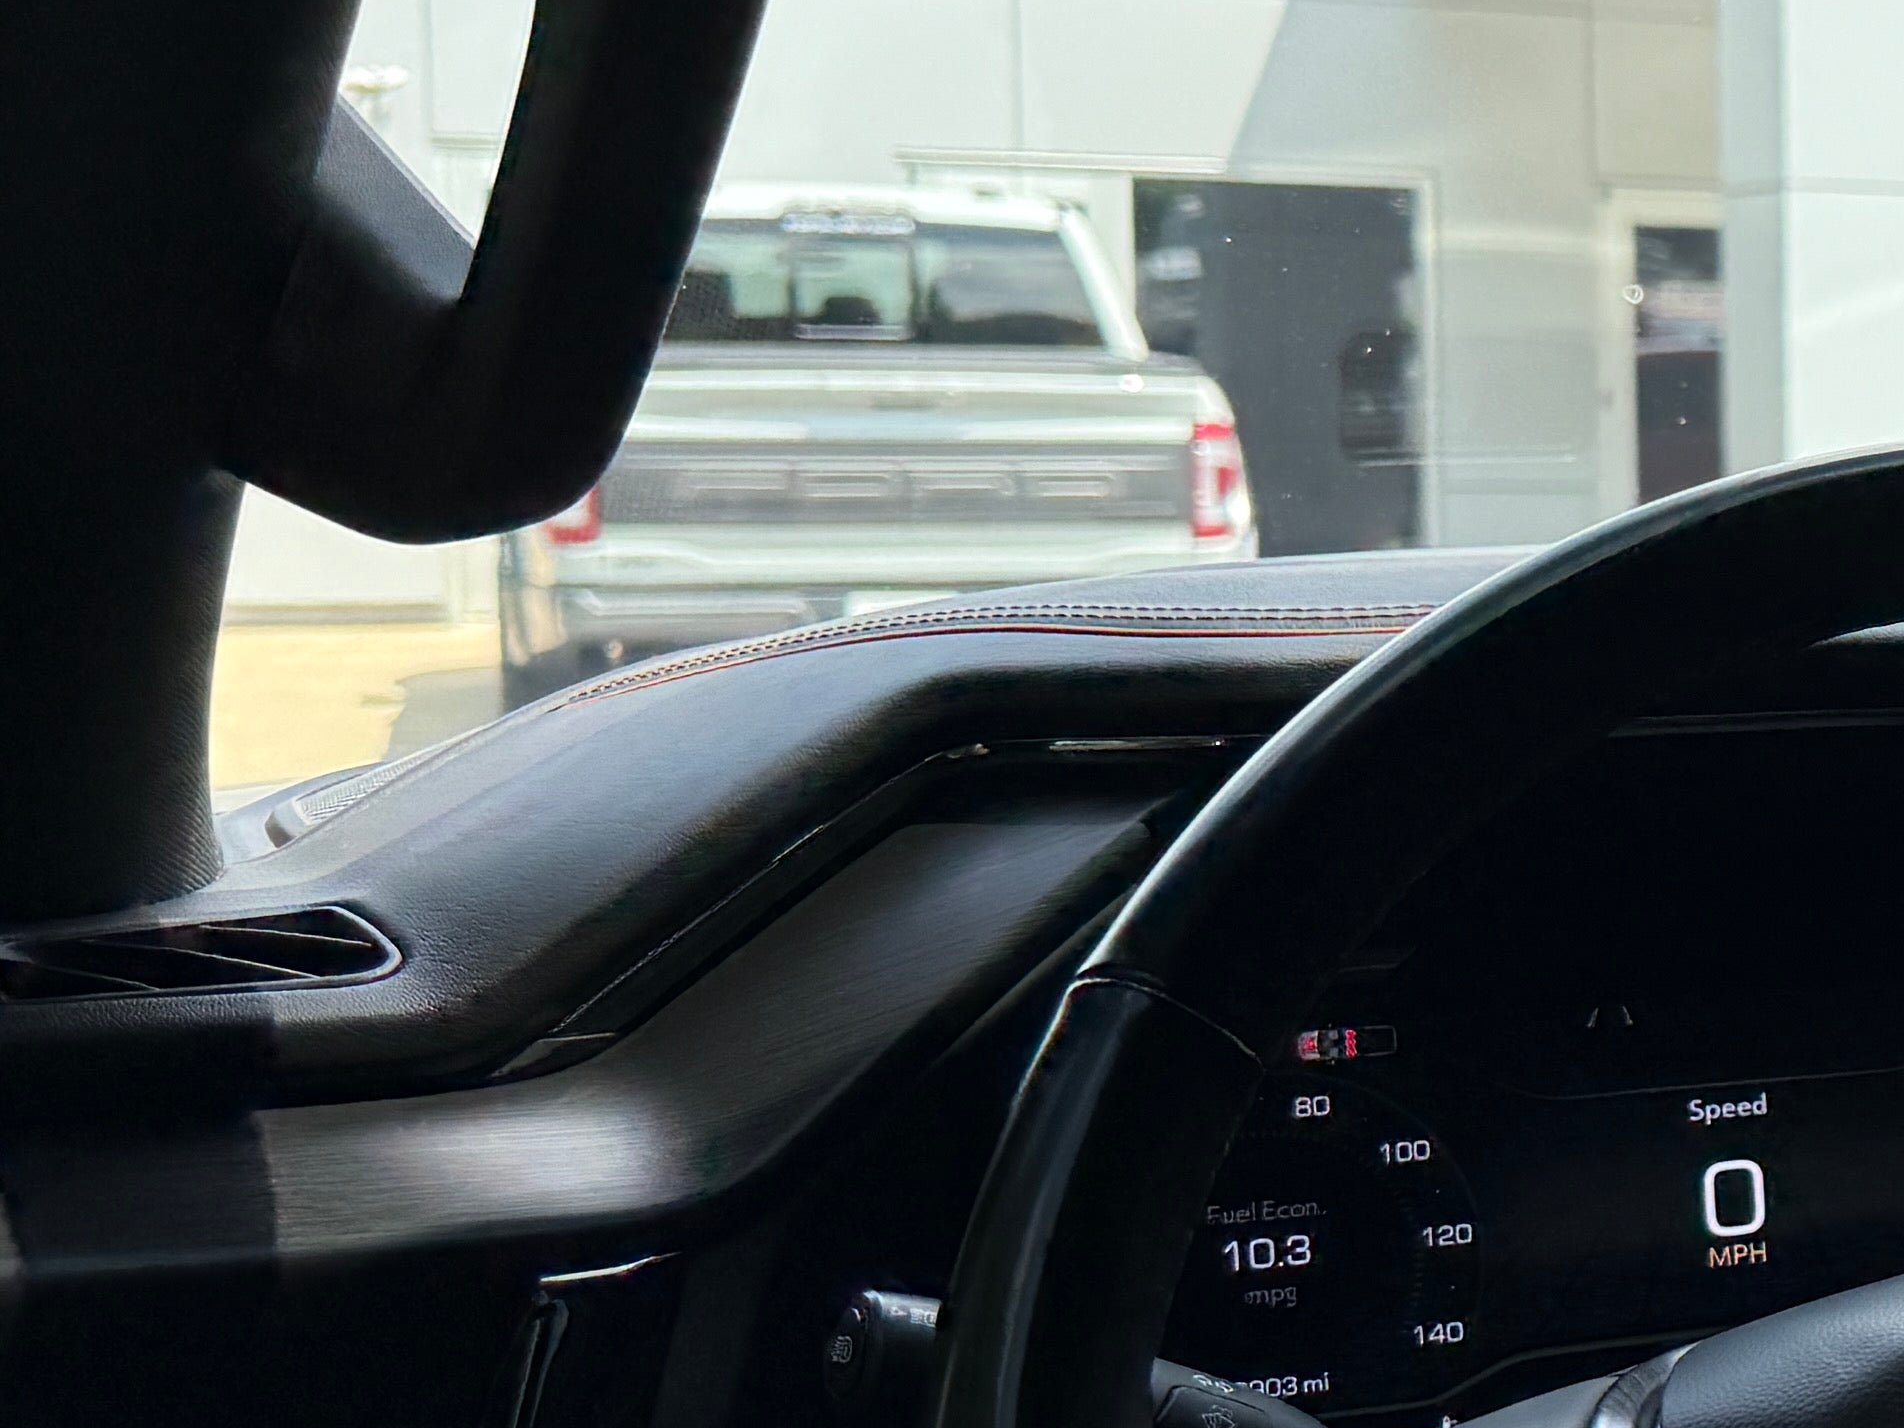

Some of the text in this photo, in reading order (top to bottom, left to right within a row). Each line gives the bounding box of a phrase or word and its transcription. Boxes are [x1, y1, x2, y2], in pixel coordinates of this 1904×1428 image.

[1294, 1095, 1331, 1119] 80
[1687, 1093, 1769, 1126] Speed
[1379, 1140, 1431, 1165] 100
[1702, 1158, 1766, 1238] 0
[1207, 1200, 1257, 1226] Fuel
[1421, 1223, 1473, 1248] 120
[1222, 1234, 1313, 1273] 10.3
[1706, 1241, 1768, 1269] MPH
[1243, 1286, 1298, 1309] mpg
[1413, 1321, 1464, 1347] 140
[1233, 1371, 1330, 1398] 903 mi
